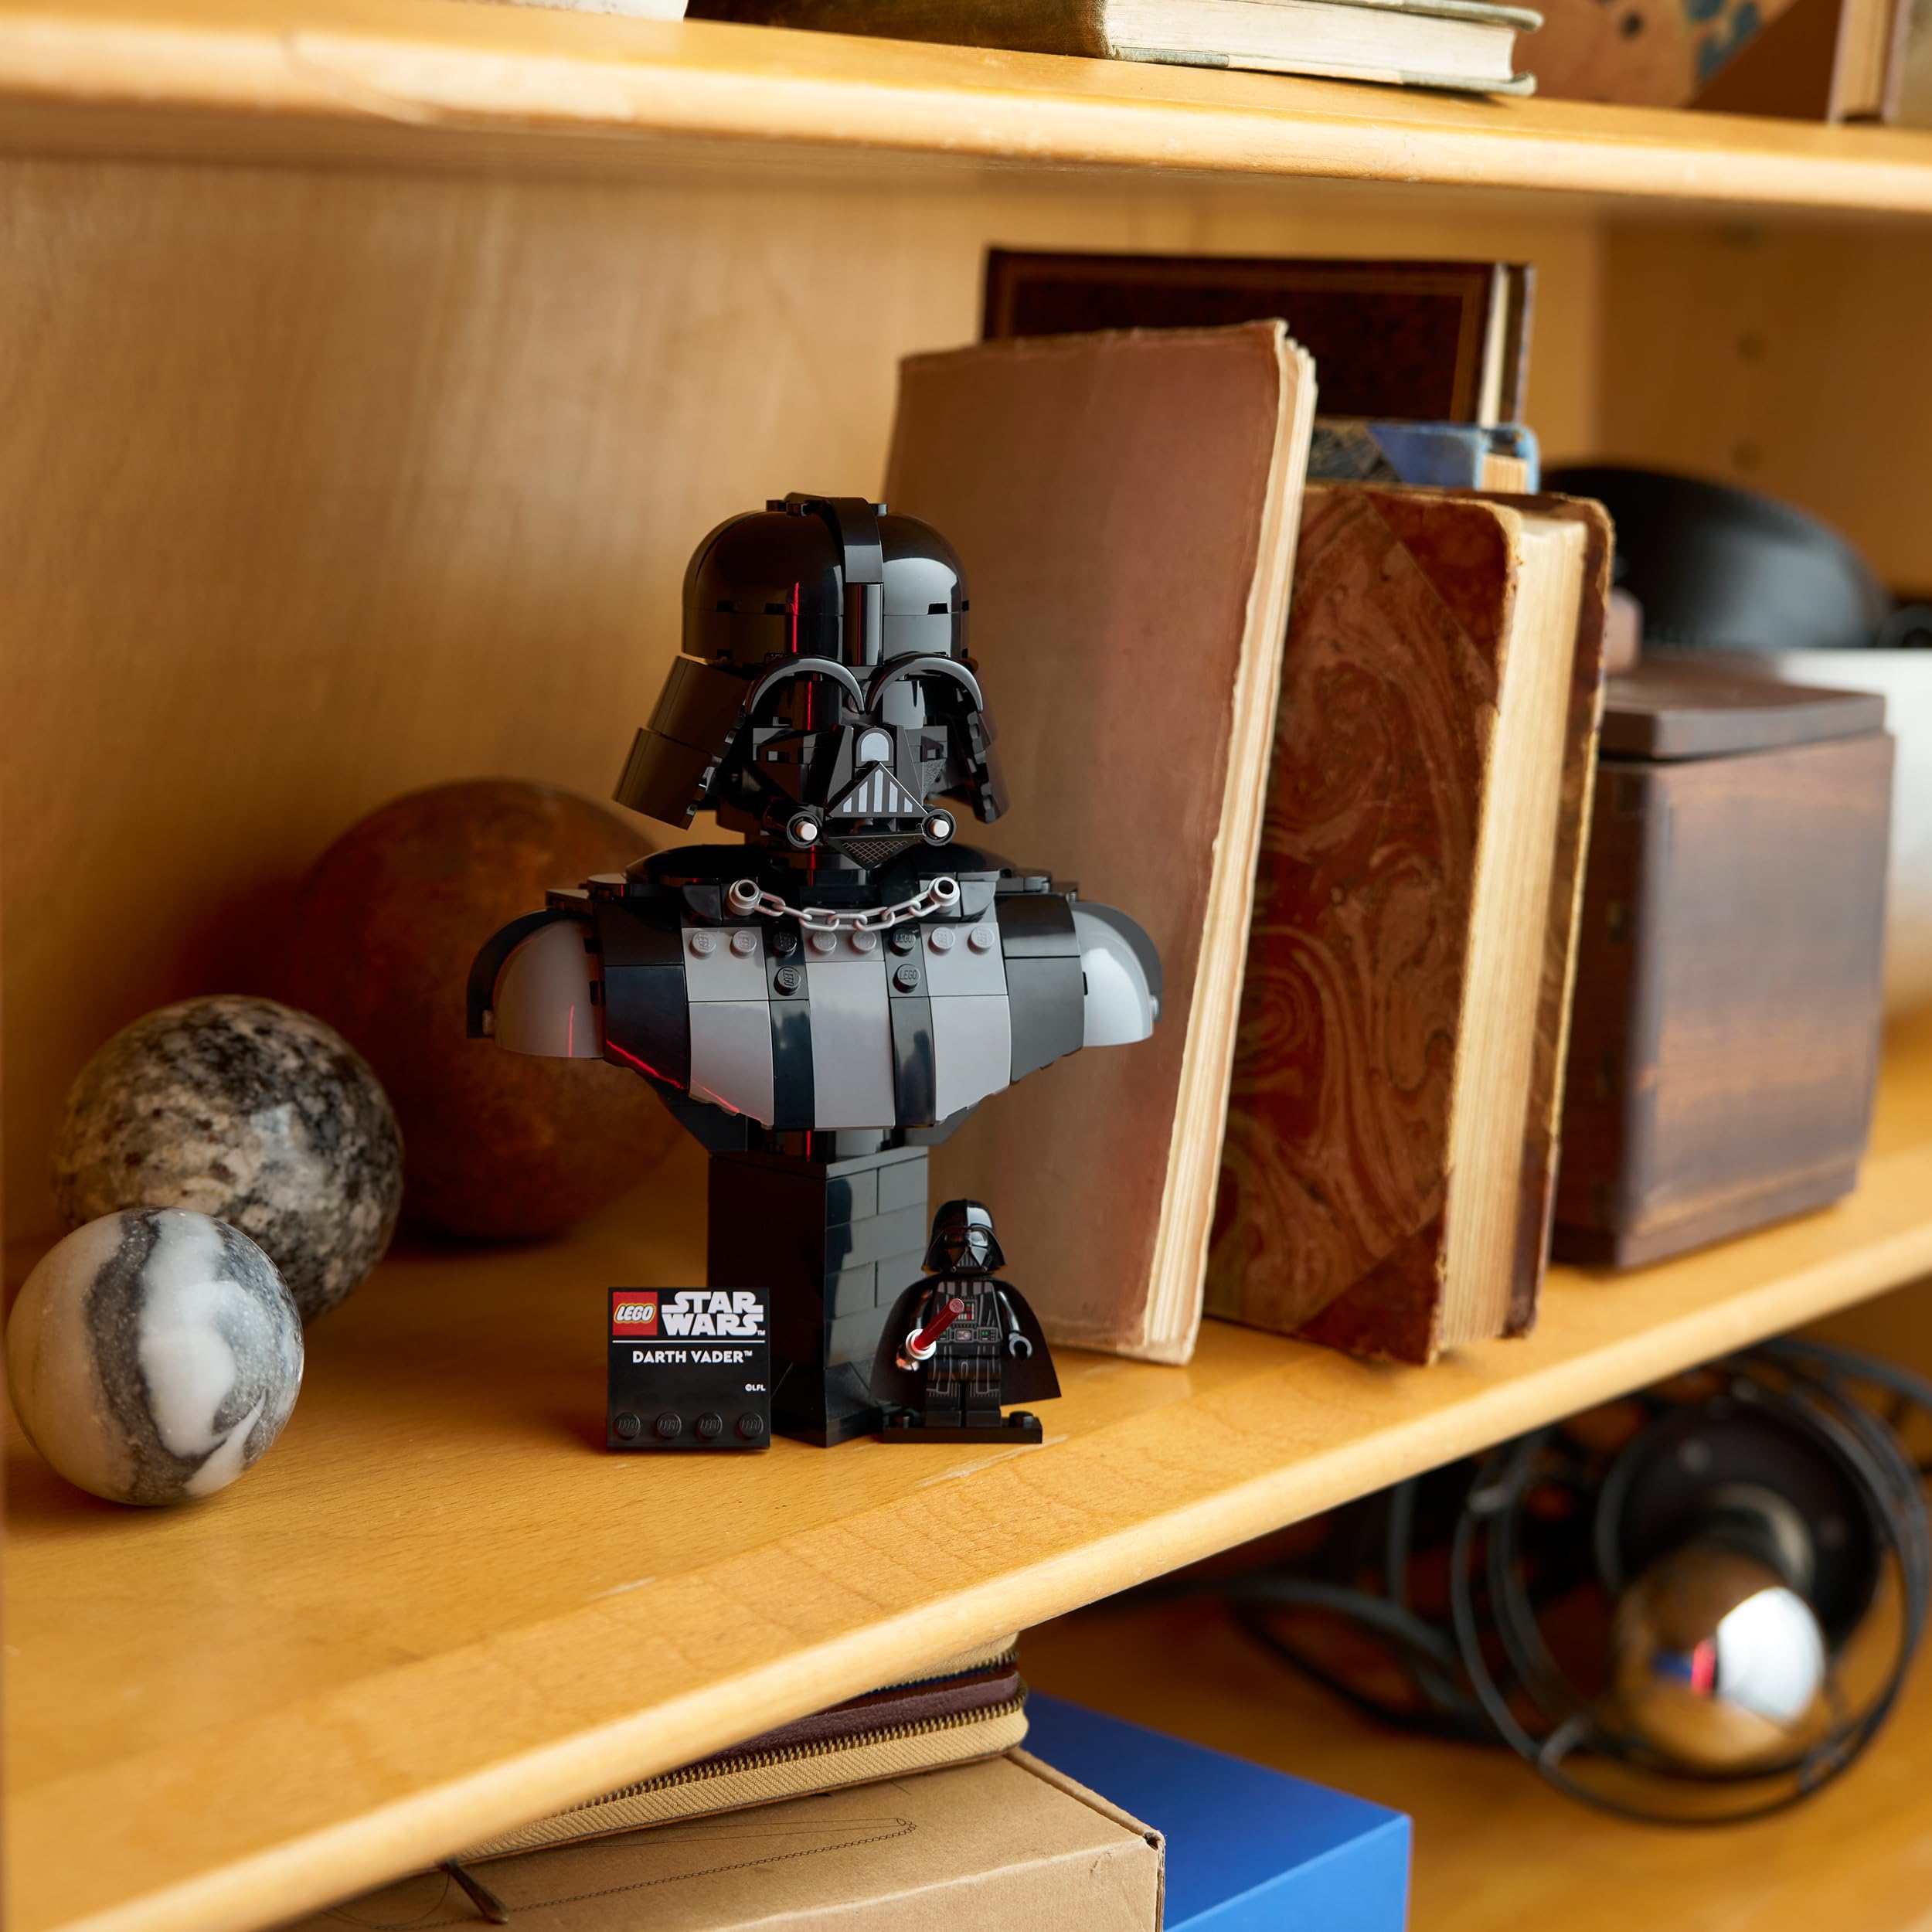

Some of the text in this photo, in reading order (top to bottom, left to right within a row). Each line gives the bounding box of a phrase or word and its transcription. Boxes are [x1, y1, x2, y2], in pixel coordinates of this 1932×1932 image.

[899, 969, 917, 980] LEGO
[662, 1291, 764, 1313] STAR
[615, 1304, 655, 1322] LEGO
[632, 1350, 687, 1363] DARTH
